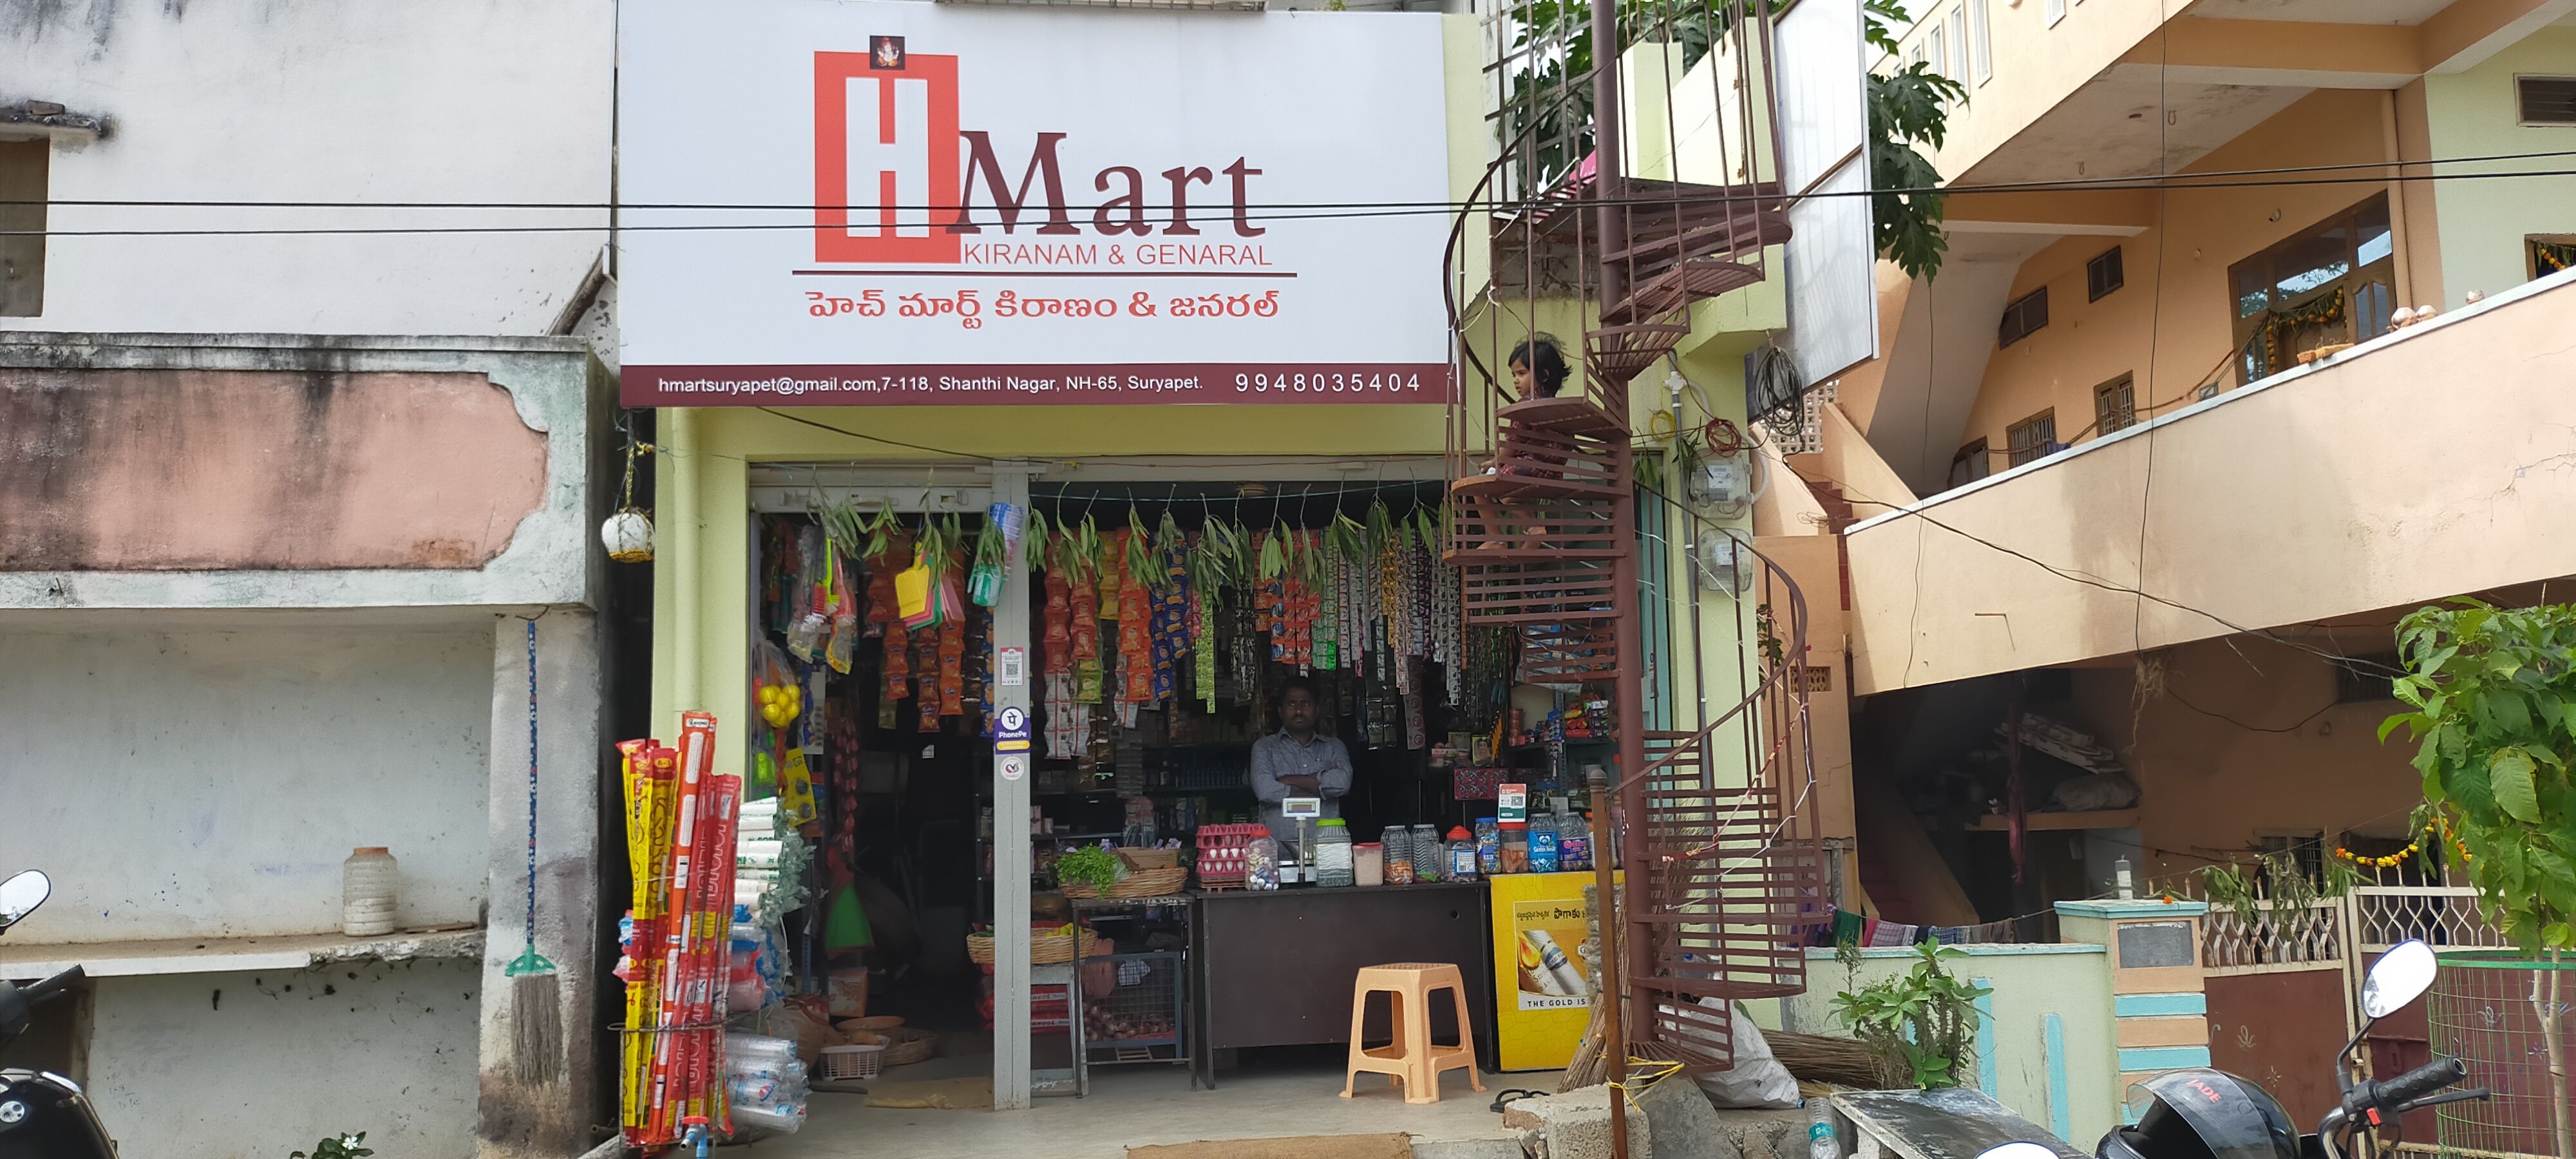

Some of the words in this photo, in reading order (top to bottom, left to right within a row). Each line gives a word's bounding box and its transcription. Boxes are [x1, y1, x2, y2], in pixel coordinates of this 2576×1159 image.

[845, 77, 930, 239] H
[946, 131, 1265, 238] Mart
[964, 244, 1097, 265] KIRANAM
[1108, 244, 1125, 265] &
[1136, 244, 1272, 267] GENARAL
[806, 290, 886, 317] హెచ్
[898, 290, 982, 329] మార్ట్
[995, 290, 1117, 318] కిరాణం
[1128, 292, 1157, 318] &
[1169, 290, 1280, 318] జనరల్
[939, 376, 1001, 390] Shanthi
[1007, 376, 1060, 393] Nagar,
[1066, 376, 1122, 391] NH-65,
[1128, 375, 1203, 393] Suryapet.
[1235, 373, 1419, 392] 9948035404
[2186, 1079, 2222, 1103] JADE
